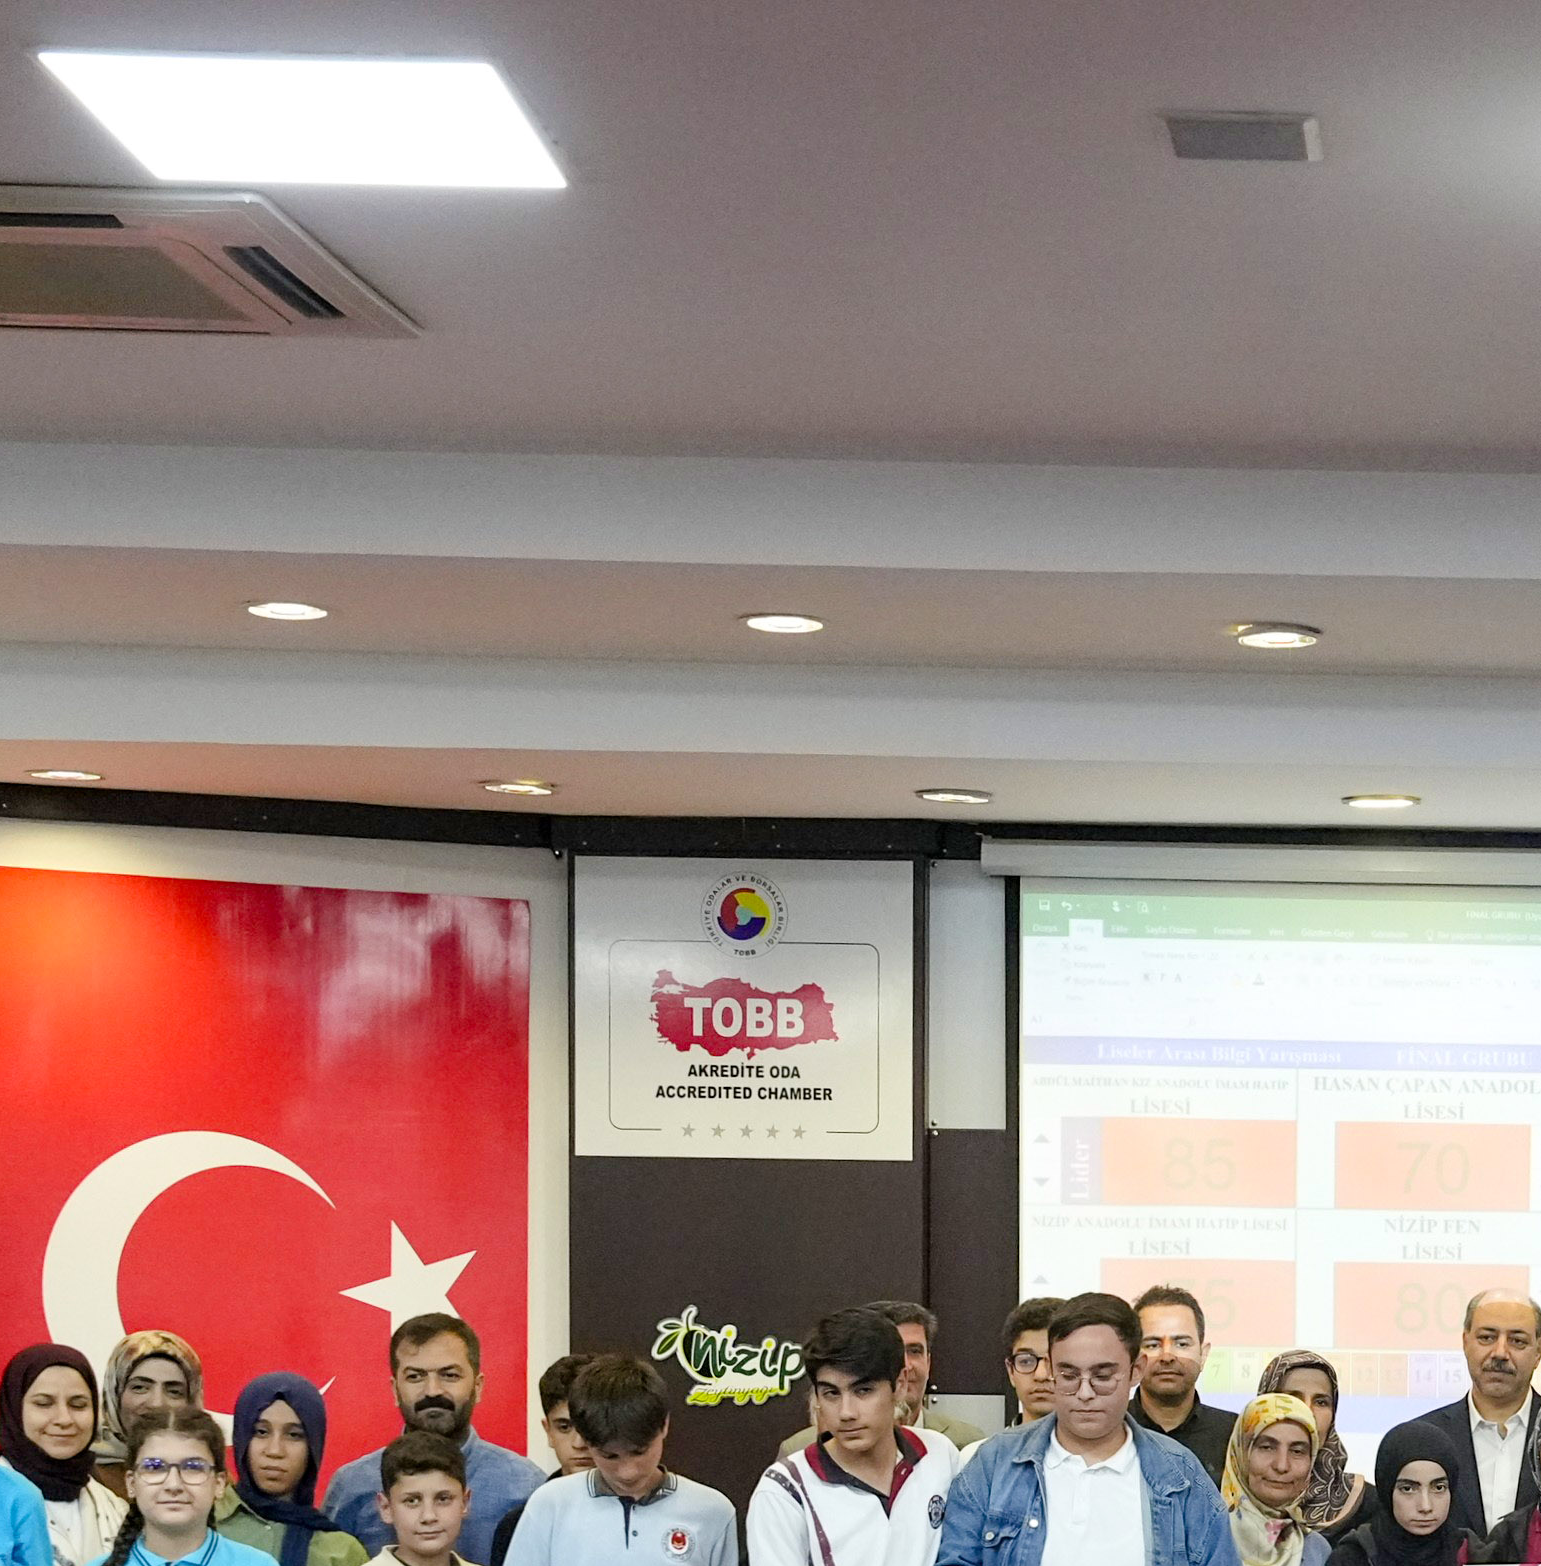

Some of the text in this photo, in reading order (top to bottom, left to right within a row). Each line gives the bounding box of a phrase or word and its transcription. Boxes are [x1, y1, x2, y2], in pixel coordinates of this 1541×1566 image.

[684, 997, 804, 1039] TOBB
[688, 1061, 801, 1079] AKREDİTE ODA
[655, 1085, 833, 1101] ACCREDITED CHAMBER
[1313, 1076, 1380, 1092] HASAN
[1163, 1137, 1237, 1191] 85
[1397, 1142, 1470, 1196] 70
[1443, 1219, 1481, 1234] FEN
